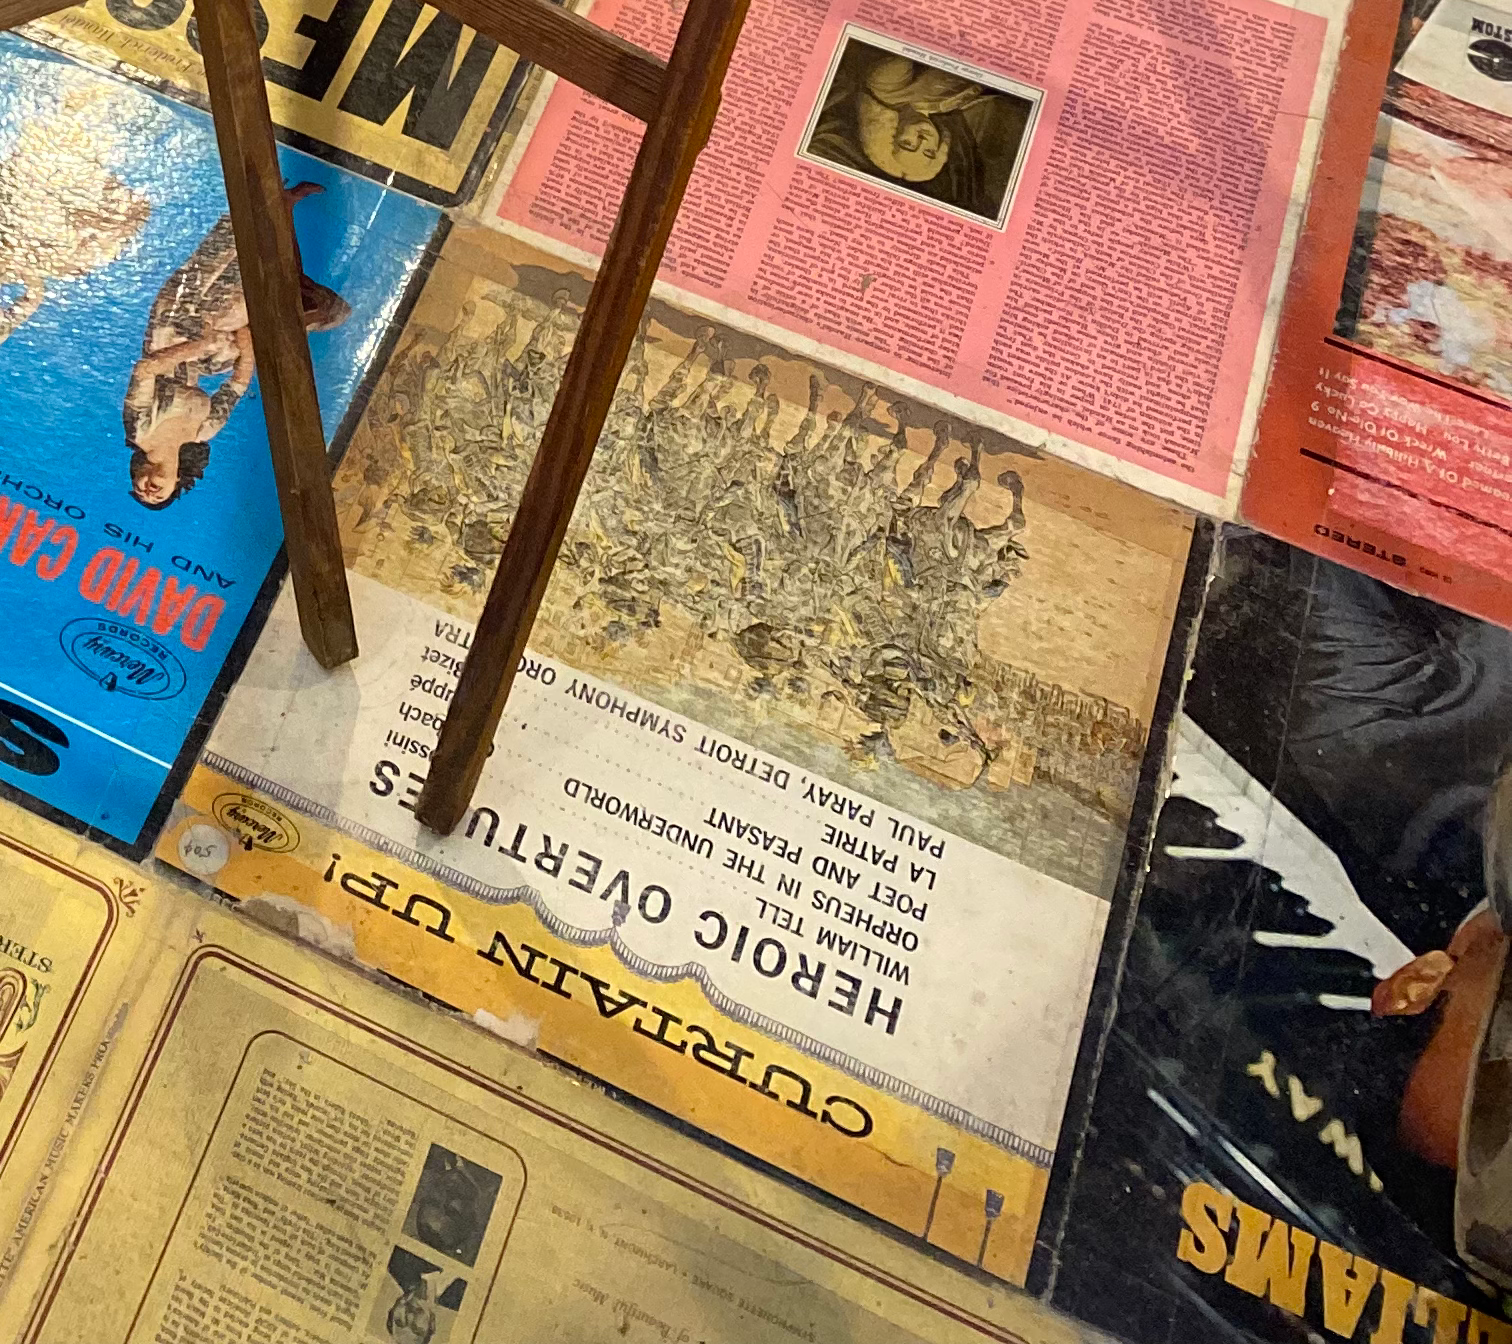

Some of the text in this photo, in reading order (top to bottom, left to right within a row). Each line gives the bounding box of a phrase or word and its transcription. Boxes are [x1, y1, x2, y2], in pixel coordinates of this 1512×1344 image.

[119, 33, 193, 75] Frederick
[1318, 366, 1329, 378] It
[1310, 400, 1319, 411] 9
[1314, 381, 1355, 406] Lucky
[1307, 416, 1360, 444] Heaven
[1379, 426, 1398, 441] Of
[1403, 435, 1447, 460] Wreck
[1361, 437, 1419, 466] Hillbilly
[1461, 476, 1511, 501] eamed
[103, 522, 153, 552] HIS
[1314, 524, 1406, 566] STEREO
[170, 554, 235, 589] AND
[79, 547, 222, 649] DAVID
[97, 617, 170, 660] RECORDS
[81, 632, 166, 693] Mercury
[434, 621, 945, 858] PAUL PARAY, DETROIT SYMPHONY ORCTRA
[239, 794, 284, 820] RECORDS
[409, 672, 927, 920] POET AND PEASANT uppé
[221, 801, 283, 843] Mercury
[563, 777, 918, 951] ORPHEUS IN THE UNDERWORLD
[820, 823, 898, 872] PATRIE
[369, 759, 902, 1033] HEROIC OVERTUES
[908, 861, 936, 889] LA
[754, 896, 910, 984] WILLIAM TELL
[322, 853, 874, 1138] CURTAIN UP!
[11, 1173, 50, 1245] AMERICAN
[43, 1127, 69, 1170] MUSIC
